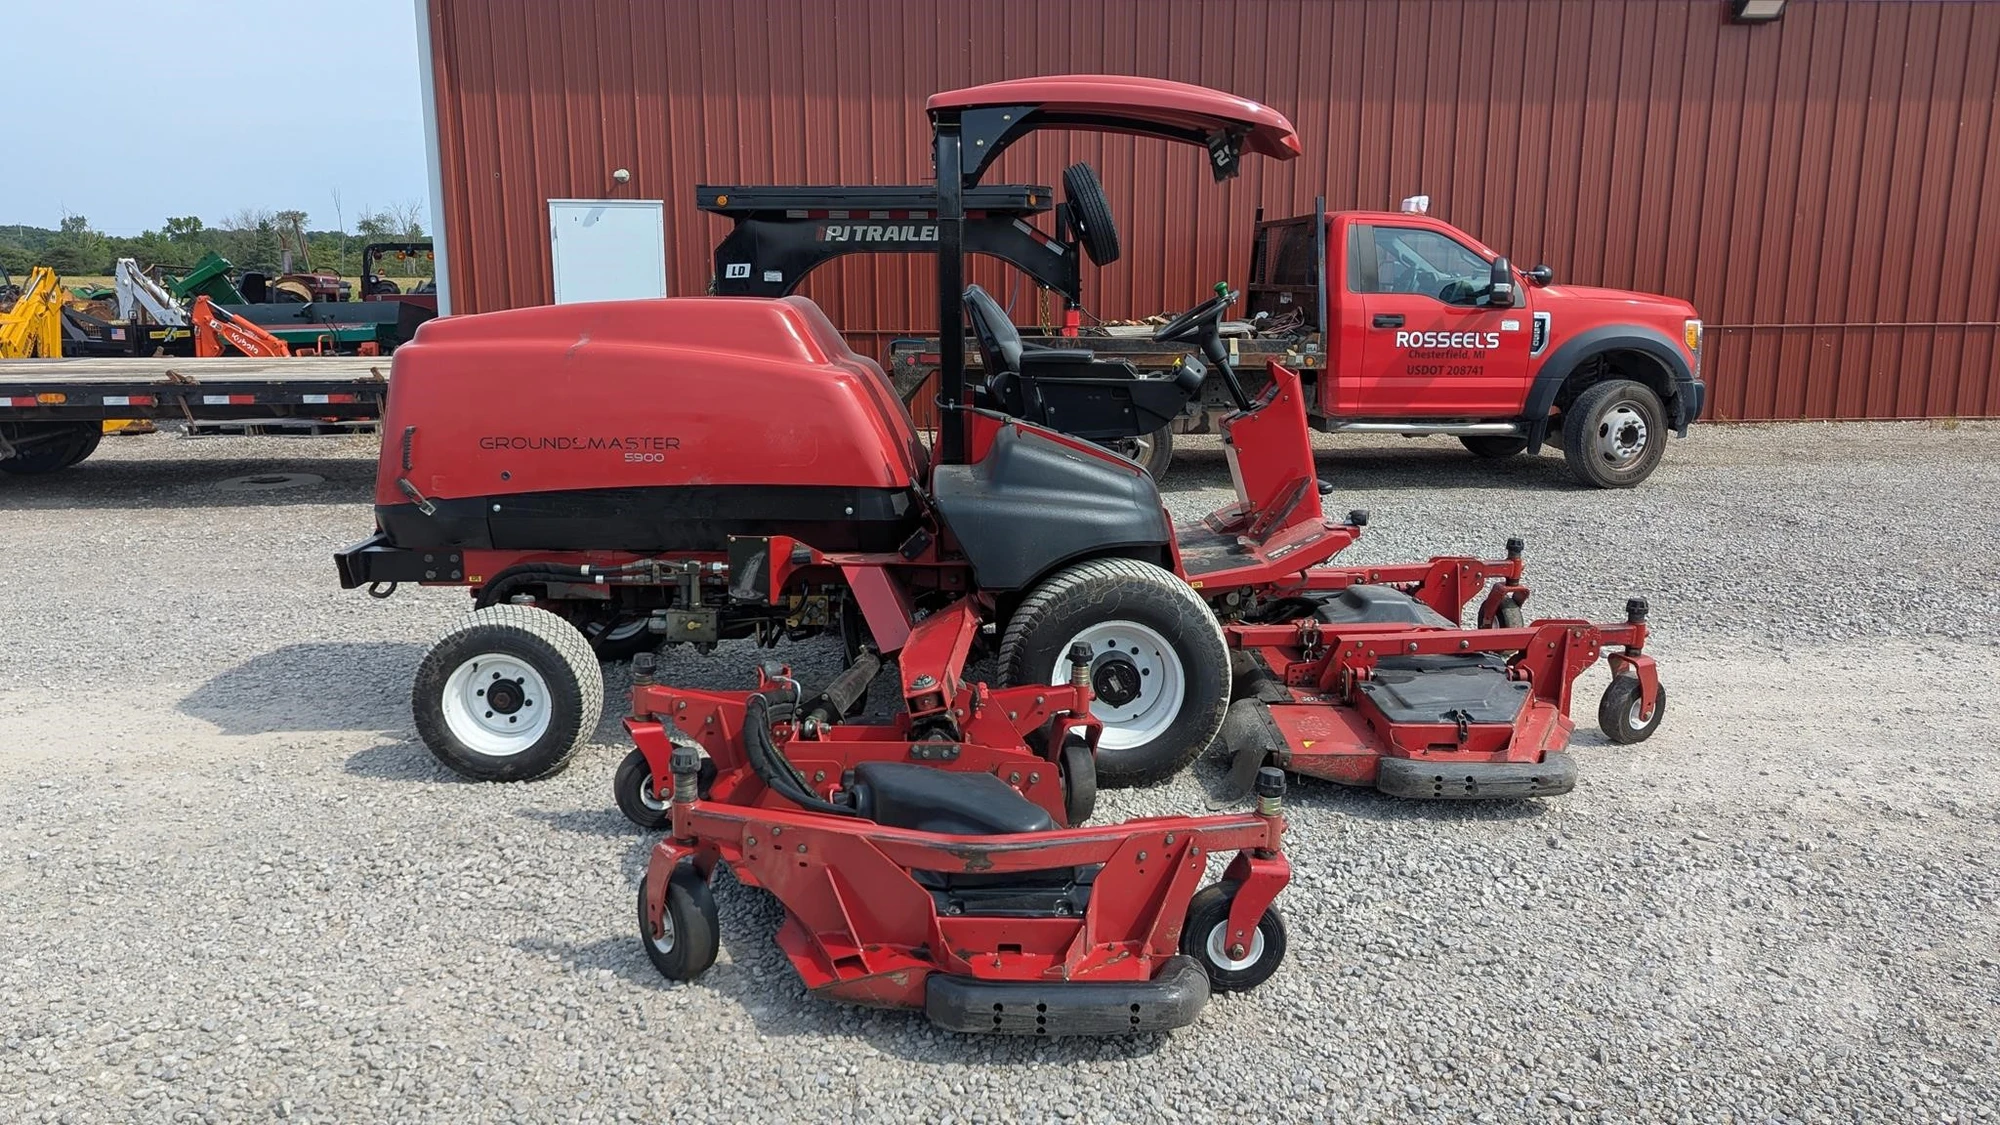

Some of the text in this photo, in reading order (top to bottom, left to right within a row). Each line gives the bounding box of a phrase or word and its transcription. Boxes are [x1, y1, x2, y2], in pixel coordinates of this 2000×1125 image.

[825, 226, 851, 241] PJ
[731, 265, 746, 276] LD
[231, 332, 259, 355] Kubota
[1396, 331, 1500, 349] ROSSEEL'S
[1408, 349, 1486, 360] Chesterfield, MI
[1406, 365, 1485, 376] USDOT 208741
[624, 452, 665, 462] 5900
